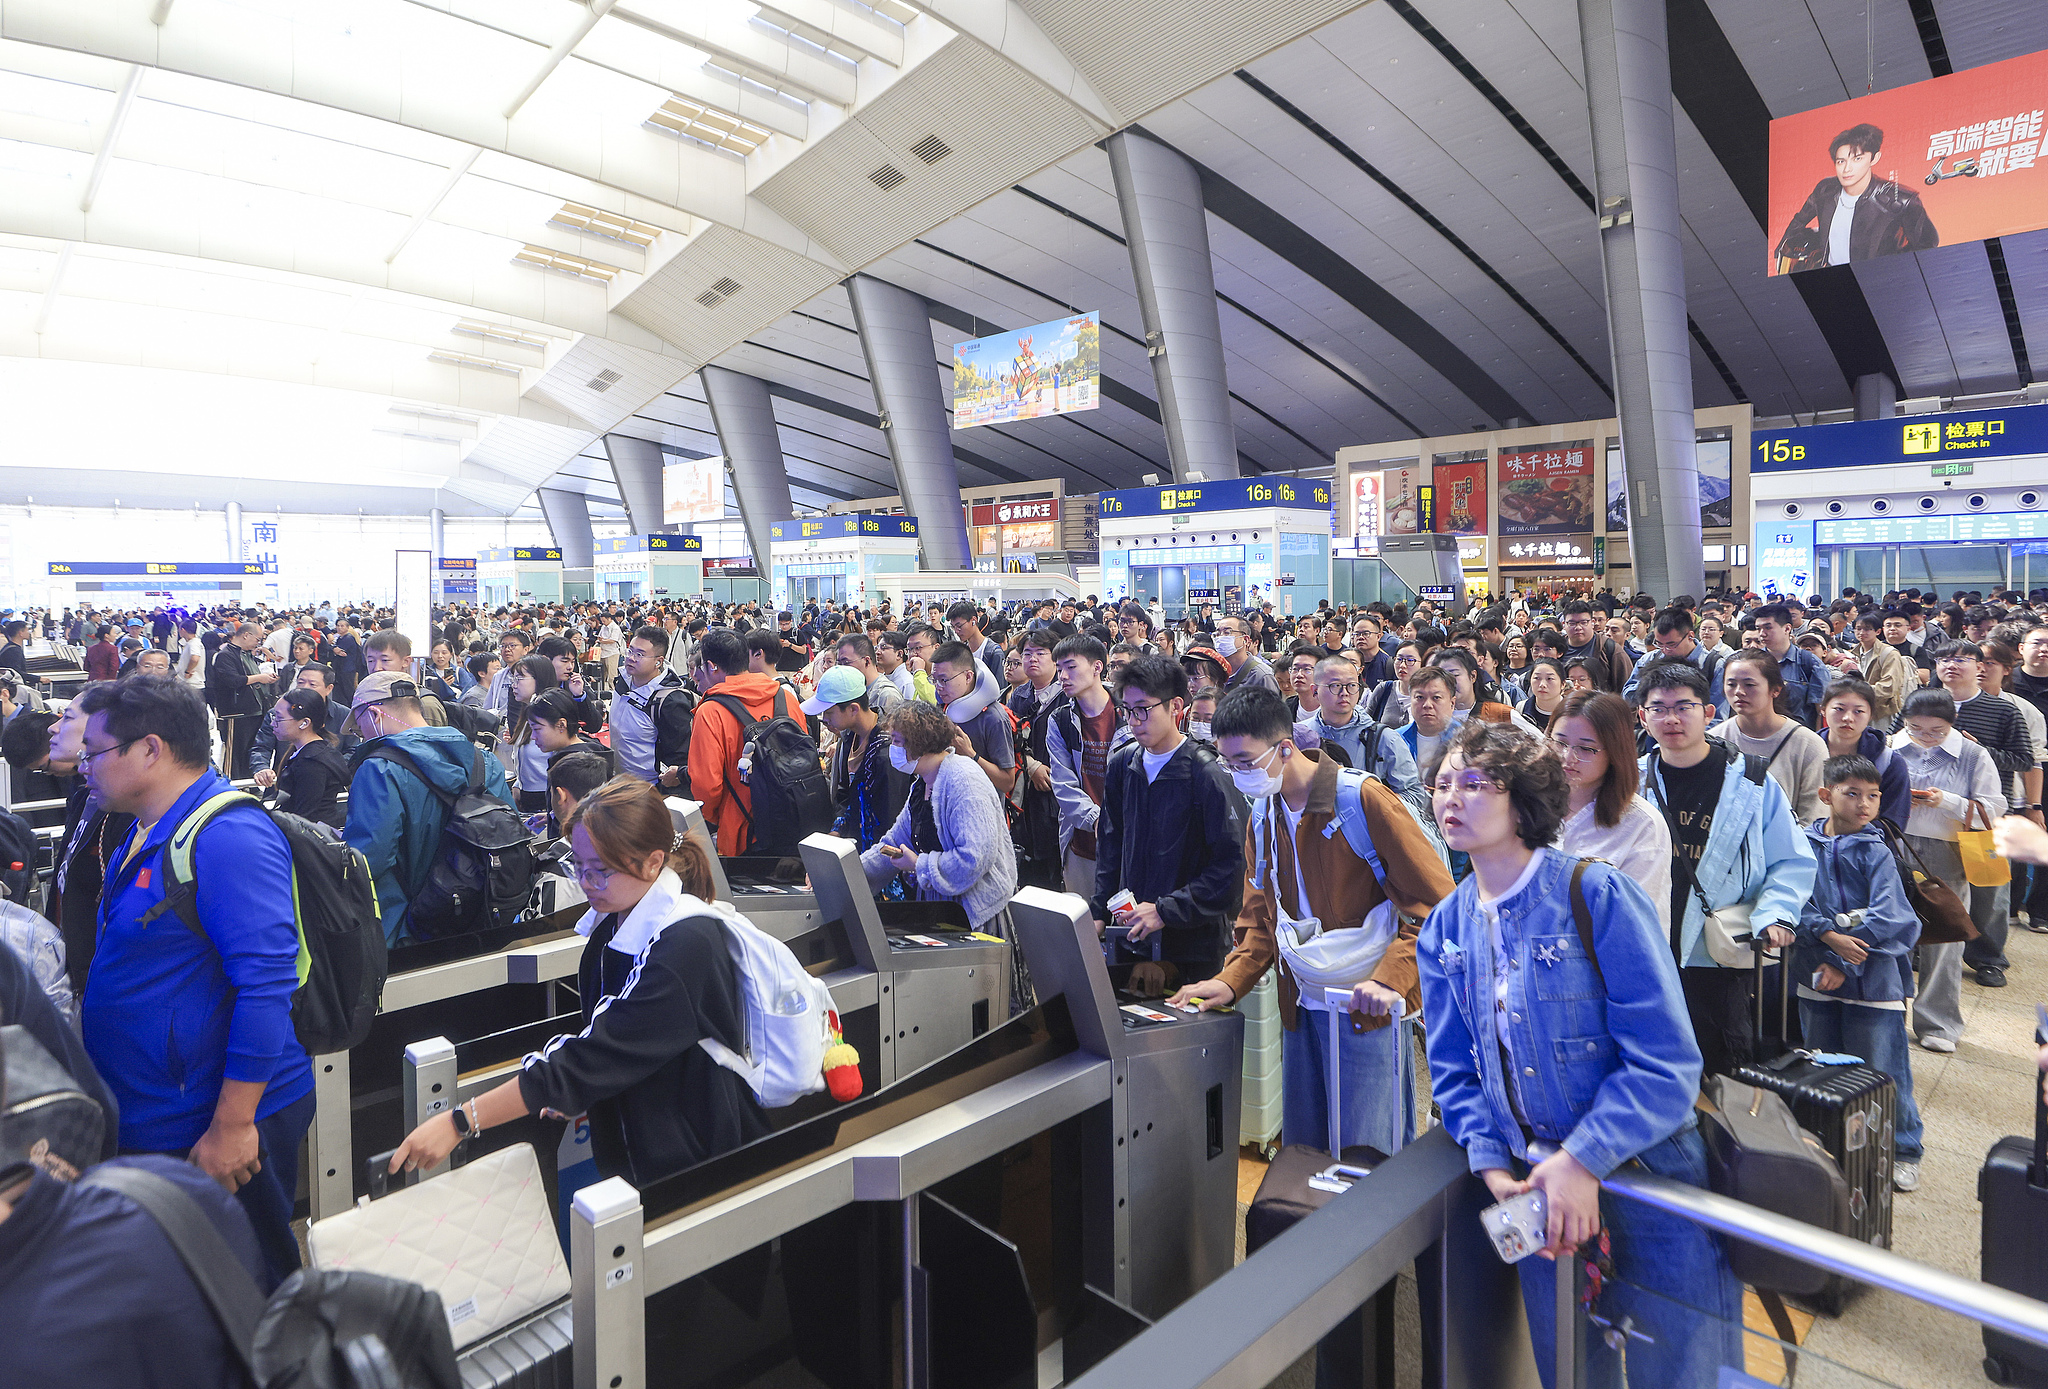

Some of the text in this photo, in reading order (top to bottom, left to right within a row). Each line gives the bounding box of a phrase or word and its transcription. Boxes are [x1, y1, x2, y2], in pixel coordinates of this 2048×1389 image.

[1926, 110, 2044, 160] 高端智能
[1976, 140, 2040, 178] 就要
[1945, 420, 2004, 439] 检票口
[1758, 439, 1806, 462] 15B
[1945, 440, 1978, 450] Check
[1178, 490, 1201, 501] 检票口
[1246, 484, 1272, 501] 16B
[1278, 484, 1295, 501] 16B
[1313, 488, 1328, 503] 16B
[1013, 504, 1050, 519] 永和大王
[1102, 497, 1122, 512] 17B
[844, 521, 857, 532] 18B
[862, 521, 879, 532] 18B
[900, 521, 915, 532] 18B
[1084, 504, 1094, 539] 售票处
[771, 527, 782, 537] 19B
[243, 539, 251, 561] Sout
[651, 538, 667, 547] 20B
[684, 539, 700, 548] 20B
[516, 550, 531, 558] 22B
[546, 550, 560, 558] 22B
[51, 564, 72, 573] 24A
[1680, 811, 1711, 832] OF G
[574, 1115, 590, 1145] 5
